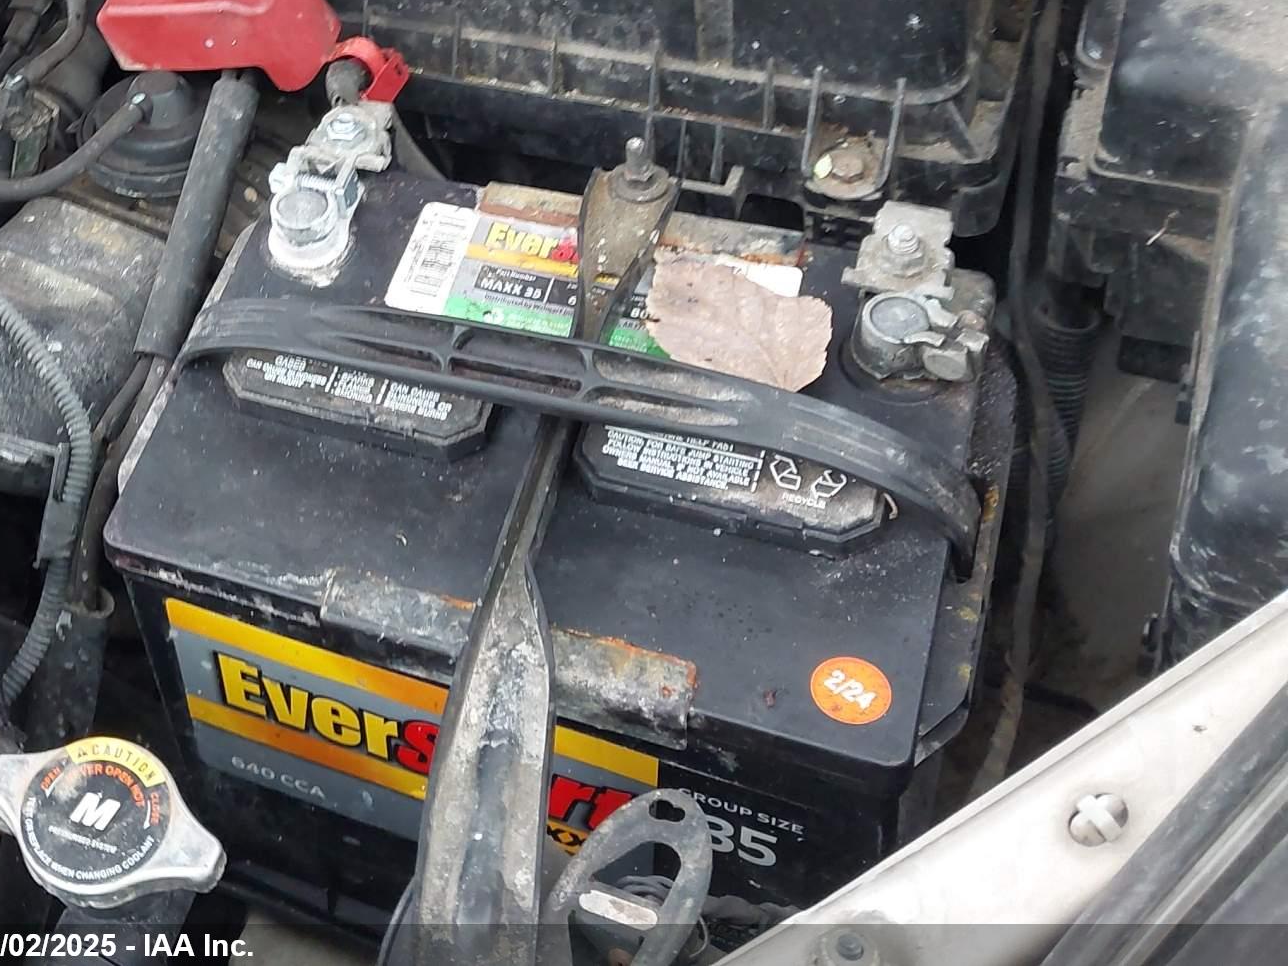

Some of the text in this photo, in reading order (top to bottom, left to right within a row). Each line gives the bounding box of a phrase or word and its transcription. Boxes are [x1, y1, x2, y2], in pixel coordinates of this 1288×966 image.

[480, 277, 524, 296] MAXX
[607, 438, 642, 454] FOLLOW
[715, 462, 750, 477] VEHICLE
[686, 465, 706, 477] NOT
[781, 492, 827, 510] RECYCLE
[823, 669, 877, 710] 2/24
[92, 743, 156, 781] CAUTION
[104, 764, 135, 787] OPEN
[231, 756, 326, 801] 640 CCA
[68, 791, 121, 831] M
[756, 812, 804, 835] SIZE
[75, 864, 123, 880] CHANGING
[121, 835, 155, 870] COOLANT
